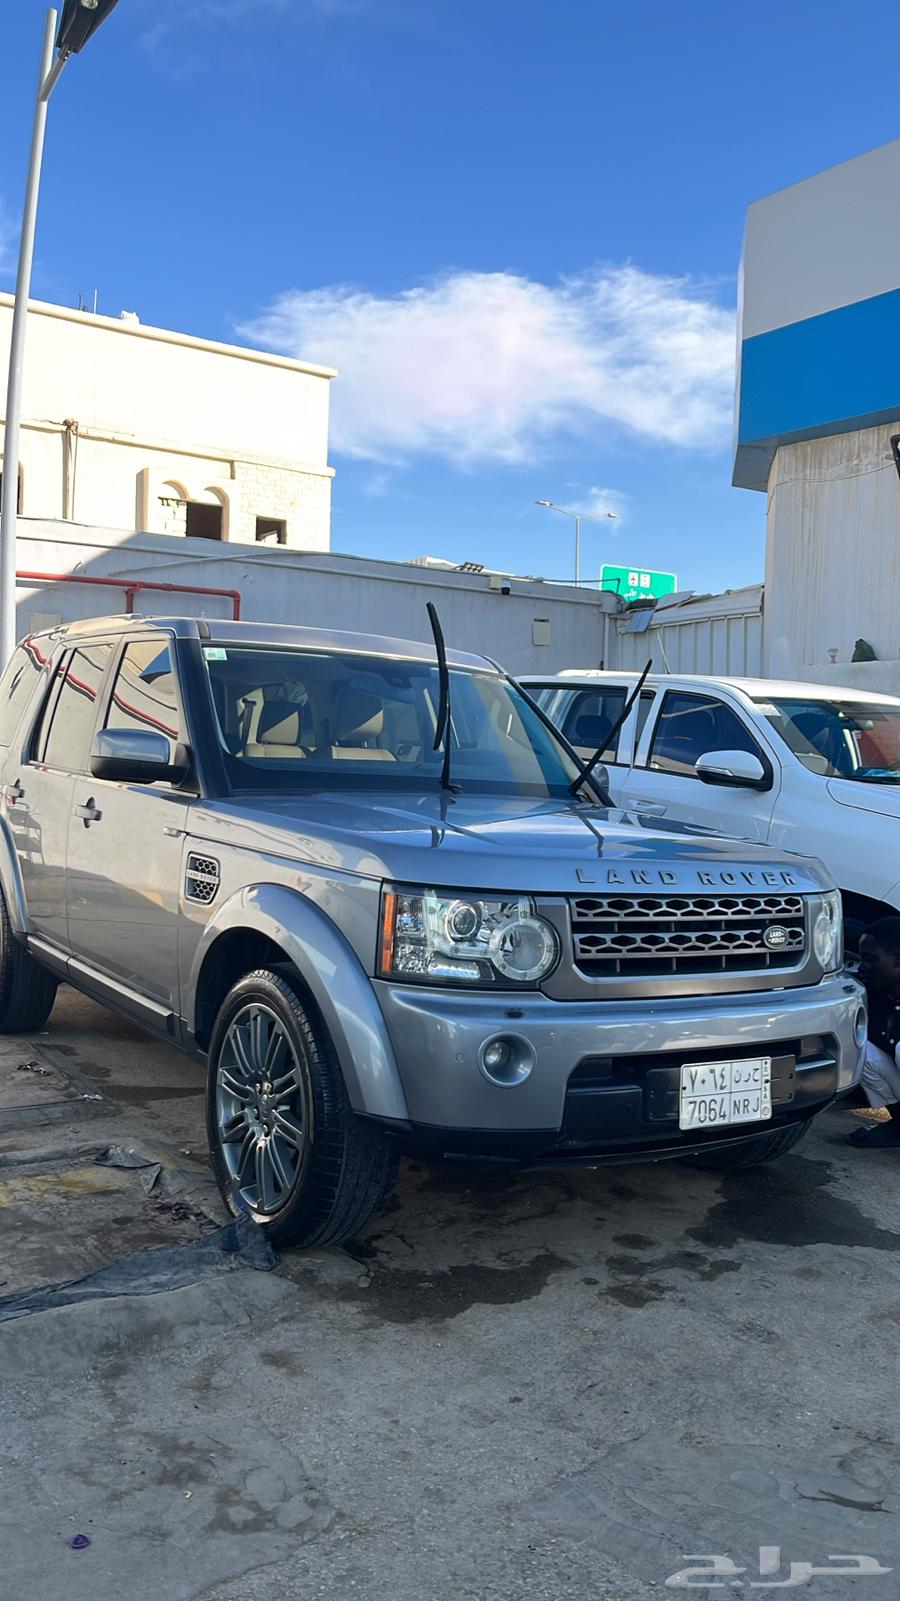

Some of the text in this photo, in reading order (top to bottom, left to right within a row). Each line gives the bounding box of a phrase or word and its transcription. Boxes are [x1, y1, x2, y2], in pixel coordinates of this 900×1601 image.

[575, 868, 796, 886] LAND ROVER
[688, 1097, 760, 1124] 7064 NRJ
